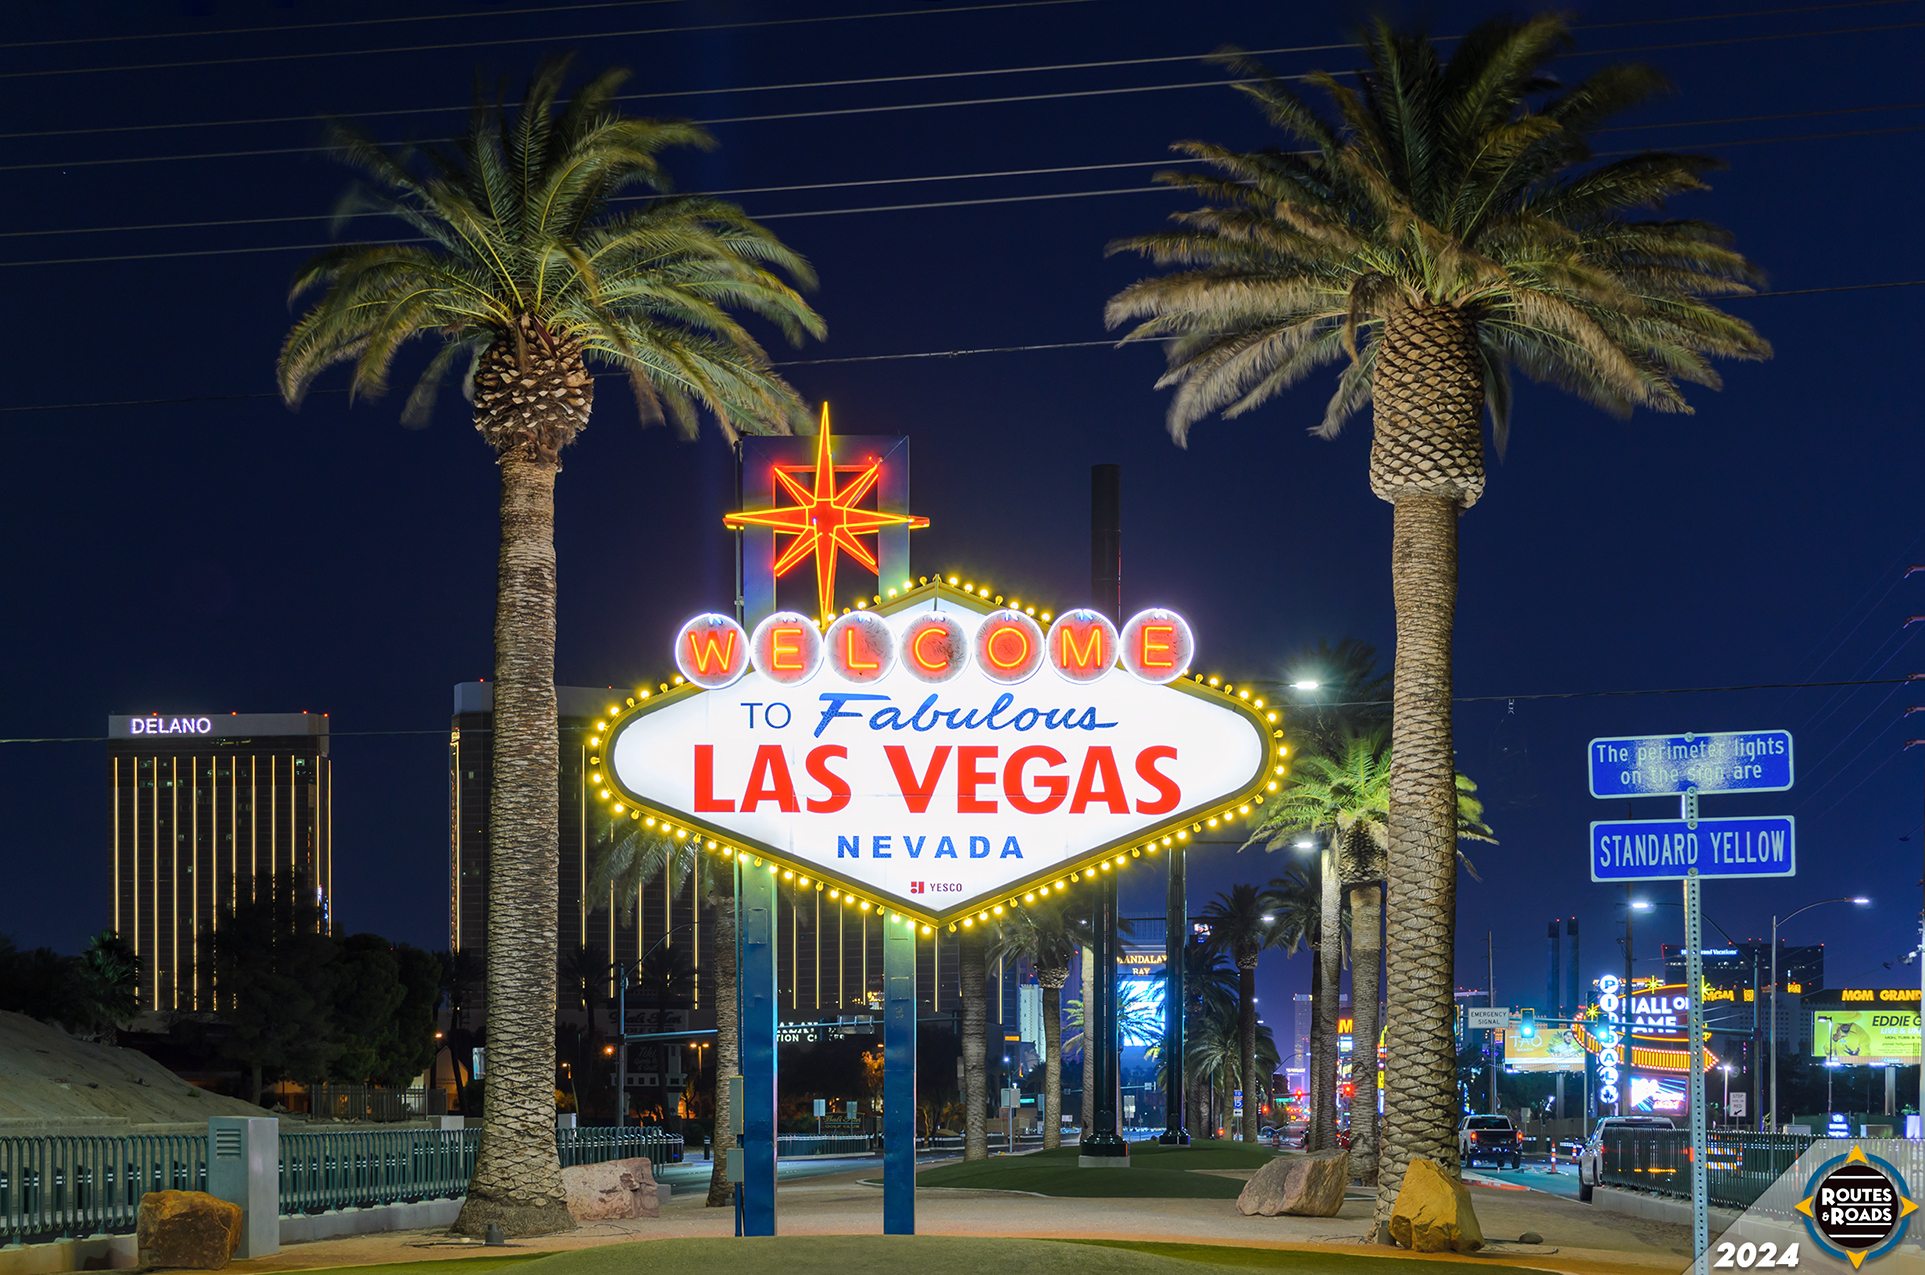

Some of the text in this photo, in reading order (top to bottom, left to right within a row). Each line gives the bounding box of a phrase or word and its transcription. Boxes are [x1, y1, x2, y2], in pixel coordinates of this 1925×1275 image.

[686, 625, 1177, 676] WELCOME
[130, 717, 212, 734] DELANO
[740, 692, 1119, 739] TO Fabulous
[1596, 737, 1785, 767] The perimeter lights
[692, 743, 1183, 815] LAS VEGAS
[1620, 764, 1763, 787] on the sign are
[837, 835, 1025, 859] NEVADA
[1599, 830, 1786, 868] STANDARD YELLOW
[929, 882, 963, 893] YESCO
[1841, 989, 1922, 1002] MGM GRAND
[1872, 1015, 1911, 1027] EDDIE
[1881, 1027, 1896, 1035] LIVE
[1509, 1034, 1543, 1048] TAO
